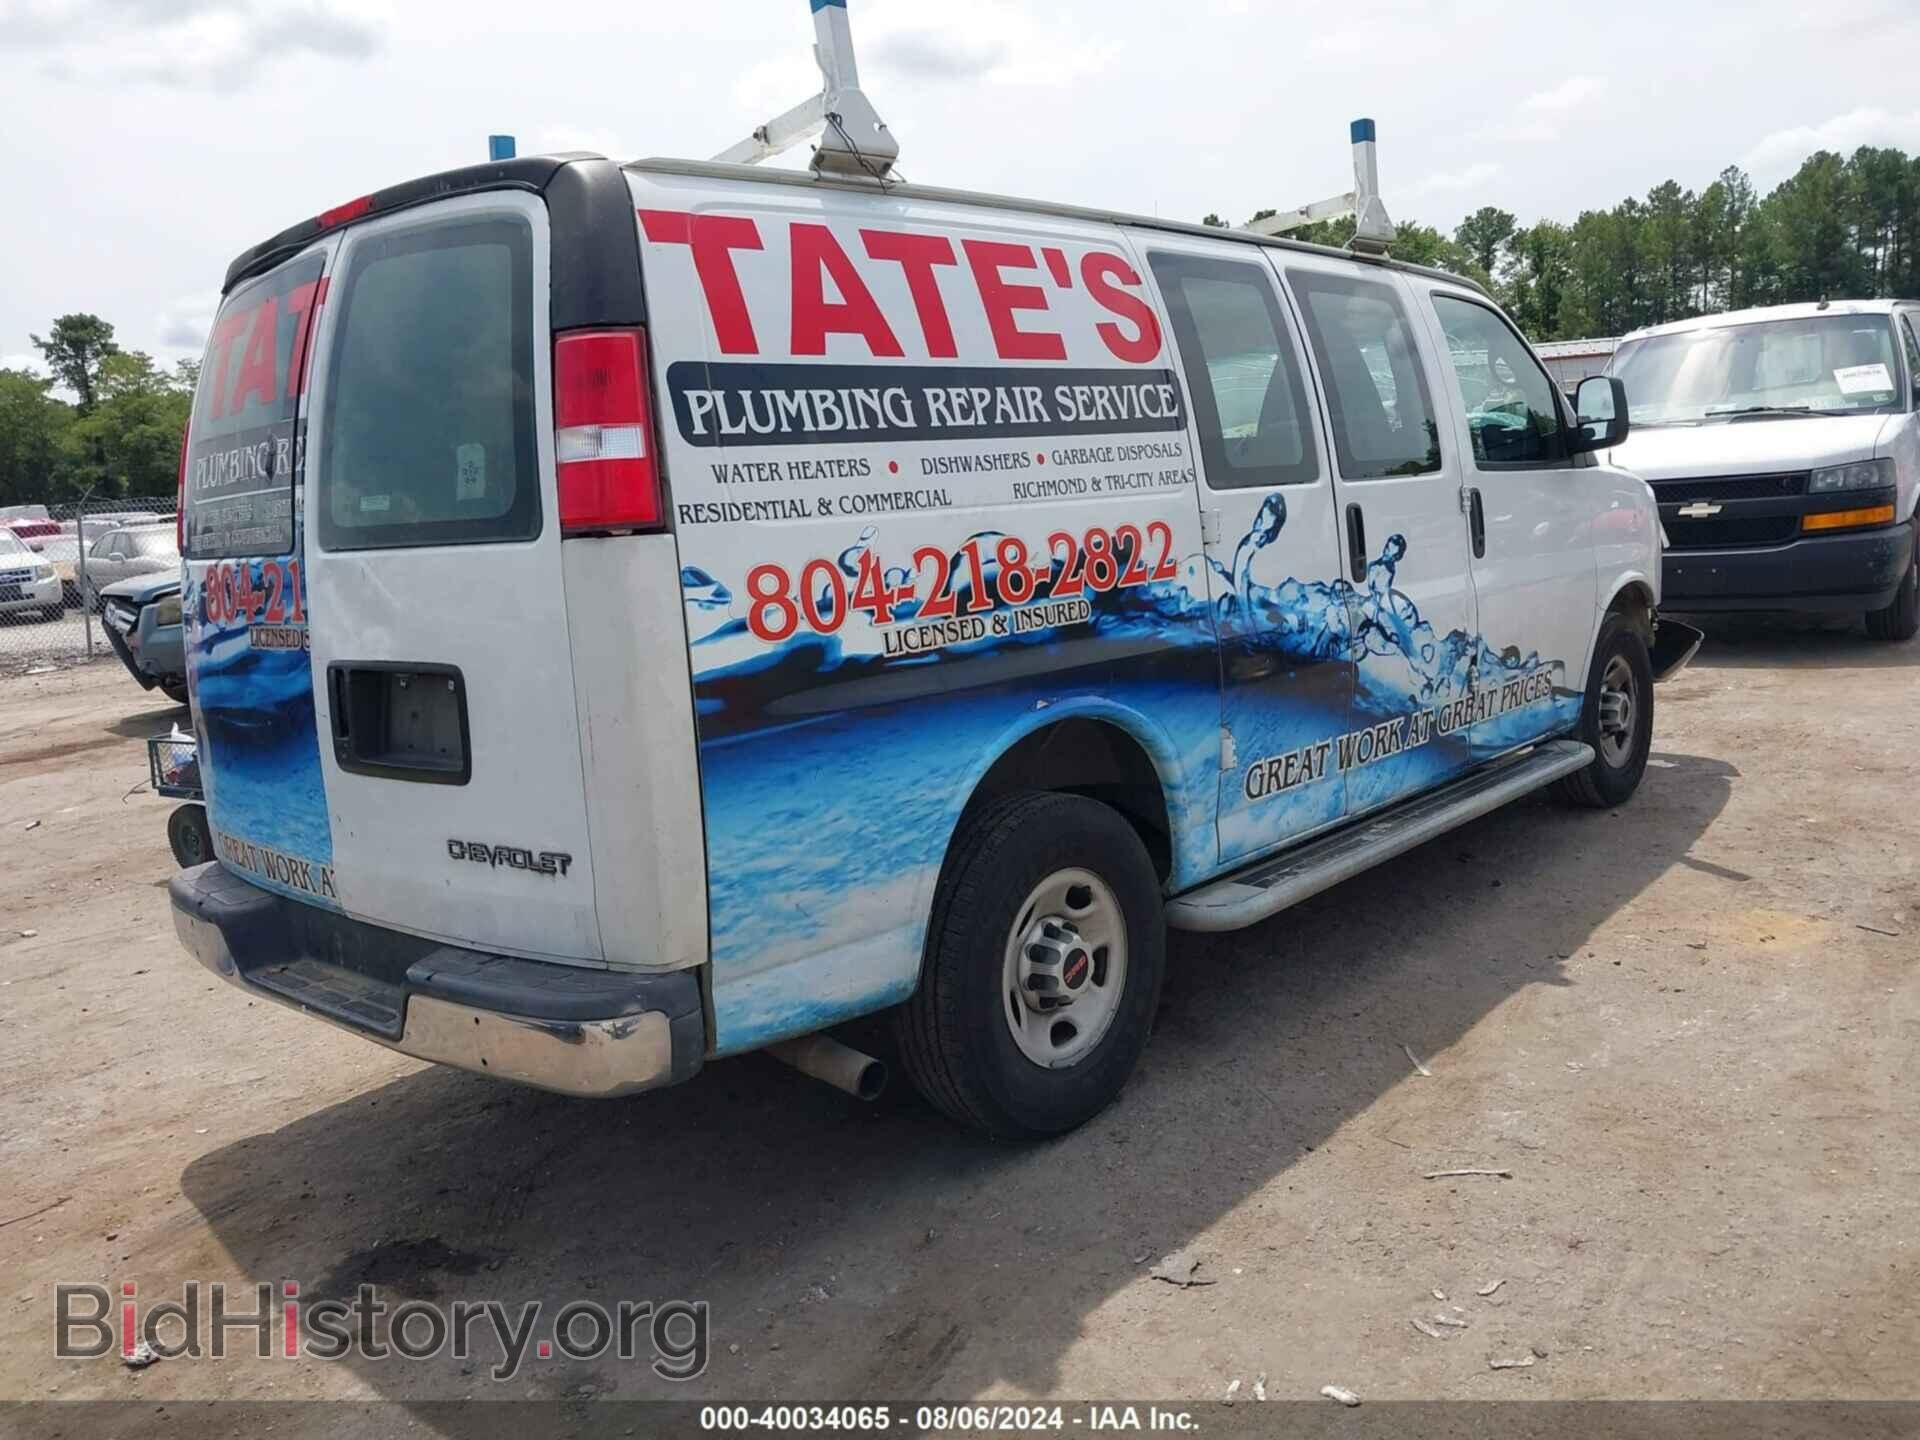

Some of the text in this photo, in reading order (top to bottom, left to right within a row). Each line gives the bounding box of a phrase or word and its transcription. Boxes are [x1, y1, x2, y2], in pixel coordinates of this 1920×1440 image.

[638, 209, 1162, 363] TATE'S
[683, 384, 1178, 435] PLUMBING REPAIR SERVICE
[711, 442, 1182, 484] WATER HEATERS DISHWASHERS GARBAGE DISPOSALS
[1013, 468, 1195, 499] RICHMOND & TRI-CITY AREAS
[678, 488, 952, 524] RESIDENTIAL & COMMERCIAL
[746, 520, 1177, 642] 804-218-2822
[250, 628, 300, 650] LICENSED
[882, 600, 1089, 655] LICENSED & INSURED
[1245, 670, 1553, 799] GREAT WORK AT GREAT PRICES
[260, 848, 318, 893] WORK
[447, 839, 572, 878] CHEVROLET
